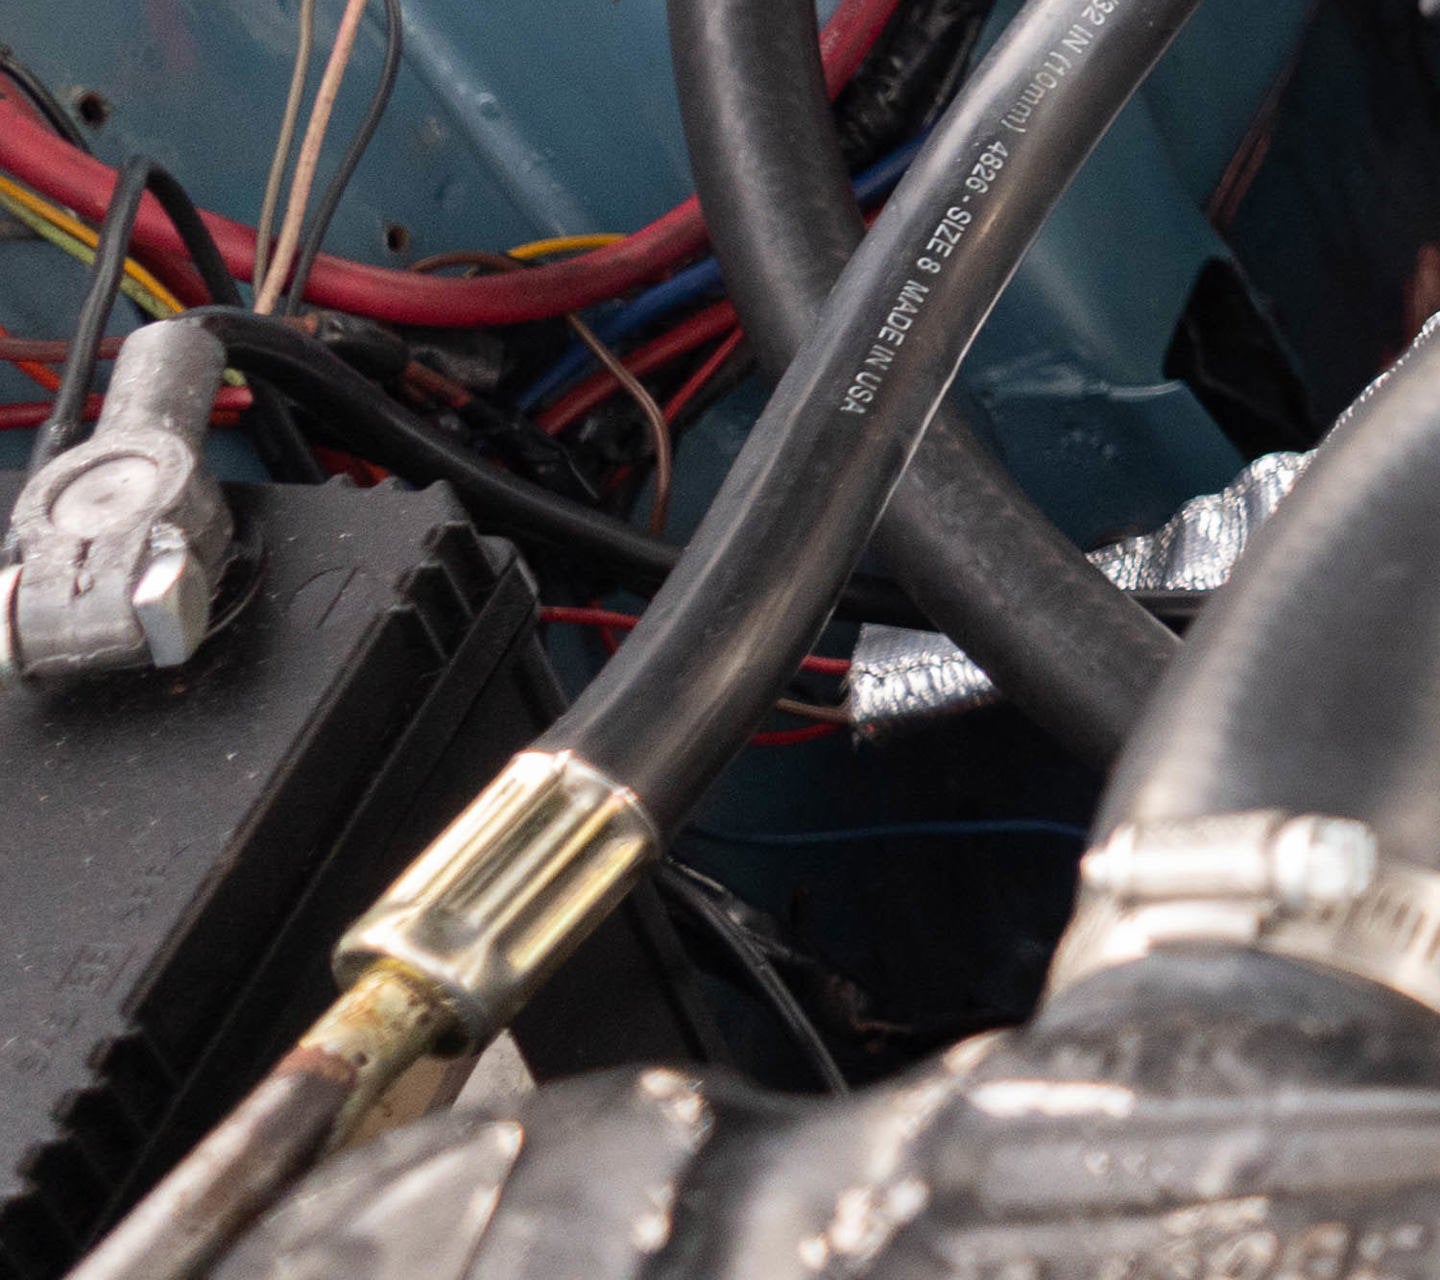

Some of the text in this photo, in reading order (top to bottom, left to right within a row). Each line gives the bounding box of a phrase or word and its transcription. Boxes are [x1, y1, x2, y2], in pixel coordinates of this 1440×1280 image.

[1060, 23, 1095, 56] IN
[1003, 52, 1071, 134] (10mm)
[965, 139, 1010, 194] 4826
[925, 203, 973, 259] SIZE
[917, 254, 942, 274] 8
[879, 279, 930, 346] MADE
[866, 339, 894, 371] IN
[840, 366, 879, 416] USA
